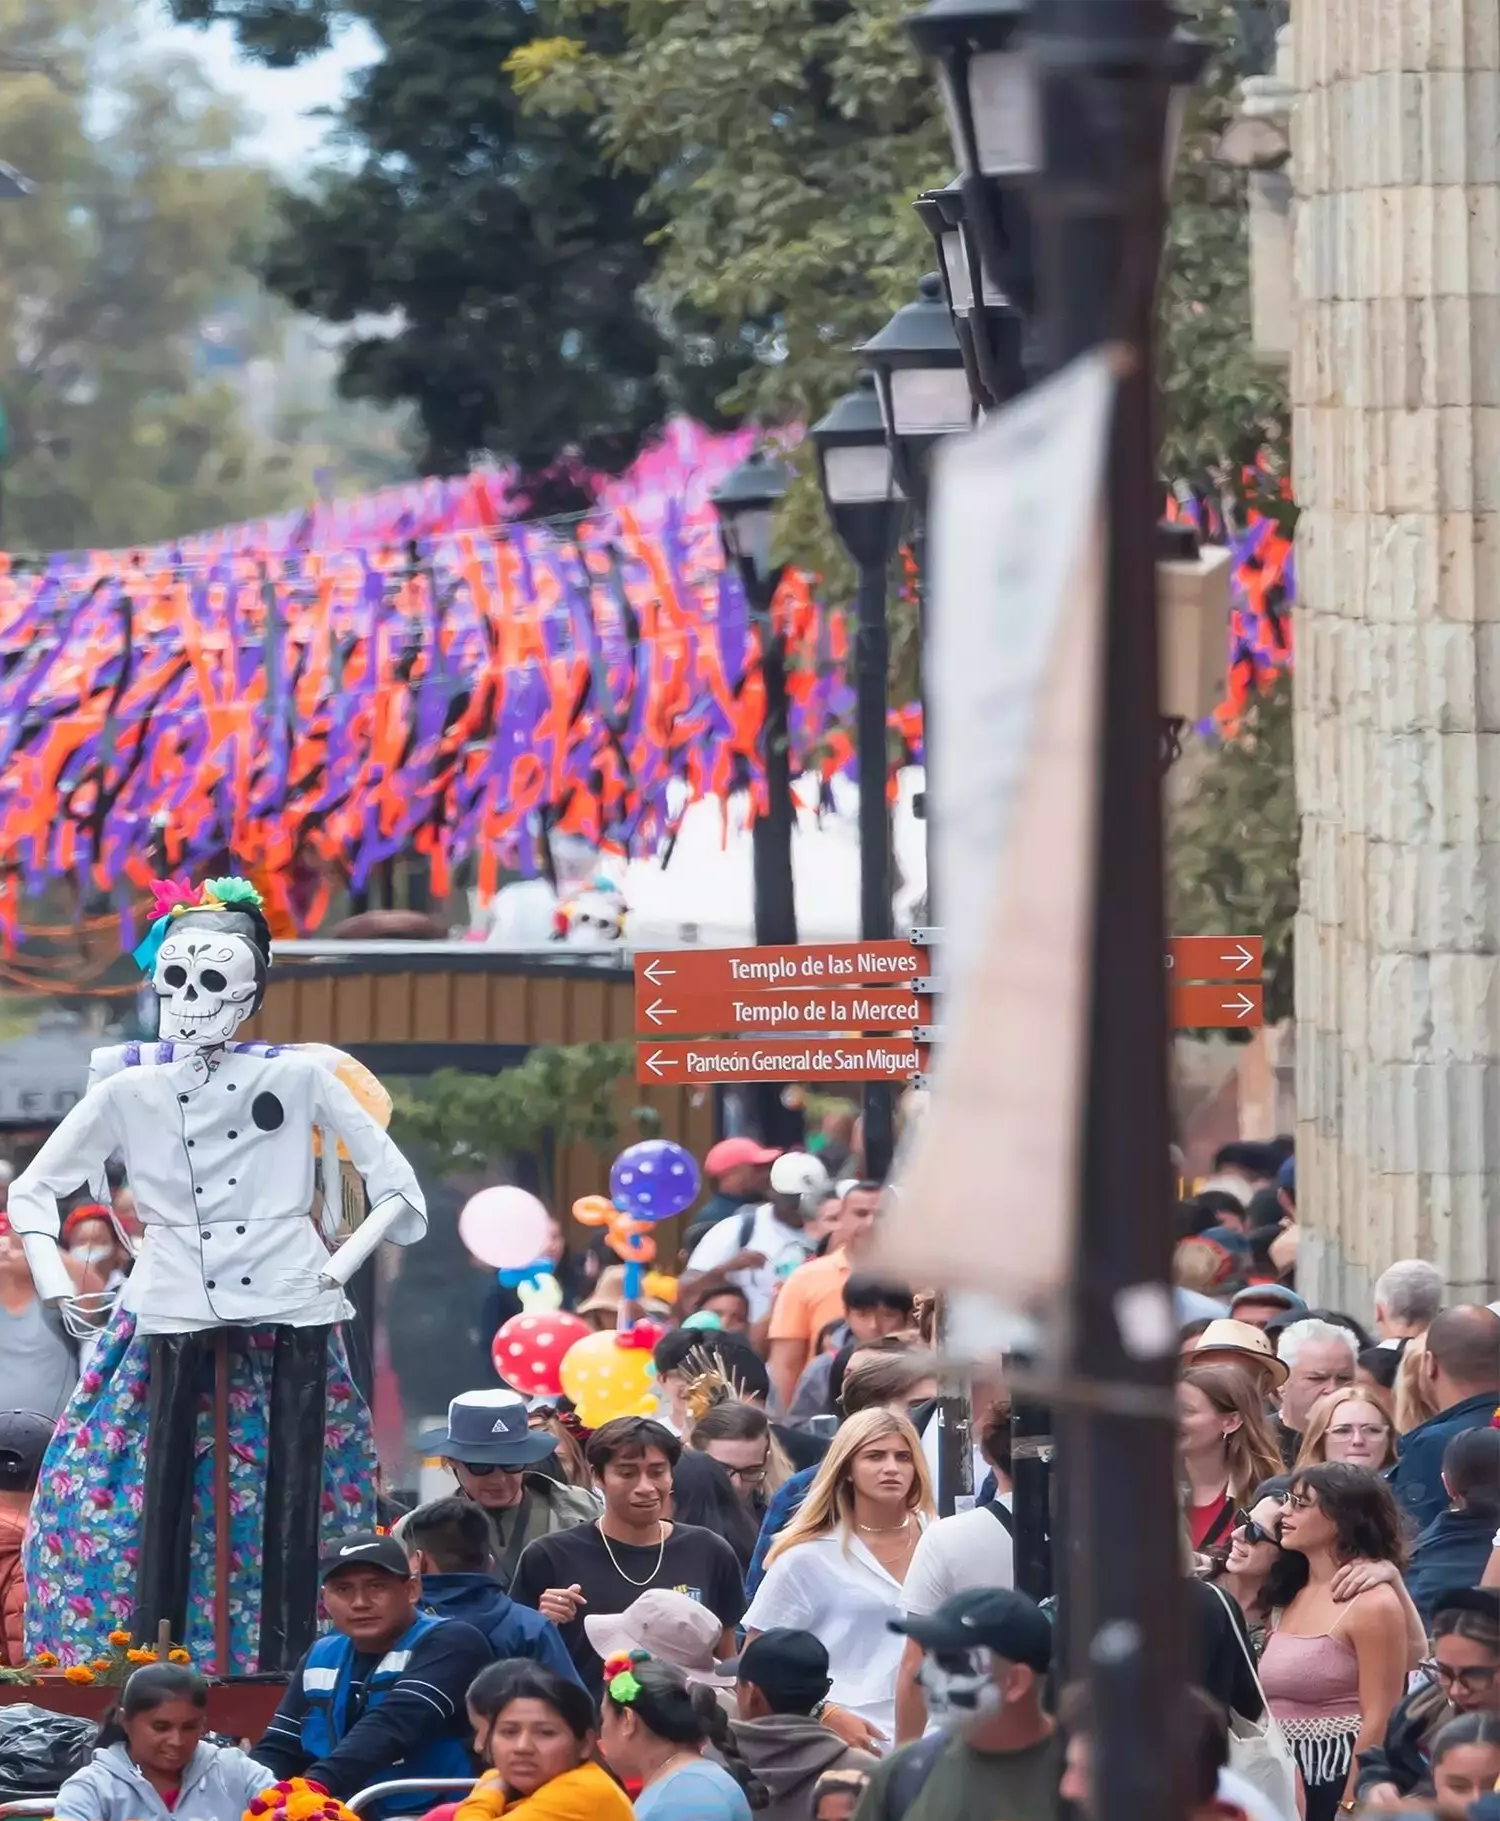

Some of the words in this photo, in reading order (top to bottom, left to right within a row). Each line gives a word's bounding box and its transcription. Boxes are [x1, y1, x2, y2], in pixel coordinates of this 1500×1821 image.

[729, 957, 797, 982] Templo
[801, 955, 824, 976] de
[828, 954, 852, 974] las
[858, 953, 918, 973] Nieves
[732, 1001, 799, 1025] Templo
[803, 1000, 826, 1020] de
[831, 1000, 847, 1020] la
[852, 999, 920, 1020] Merced
[686, 1051, 750, 1072] Panteón
[751, 1049, 810, 1070] General
[812, 1049, 833, 1070] de
[834, 1049, 864, 1070] San
[866, 1048, 920, 1074] Miguel
